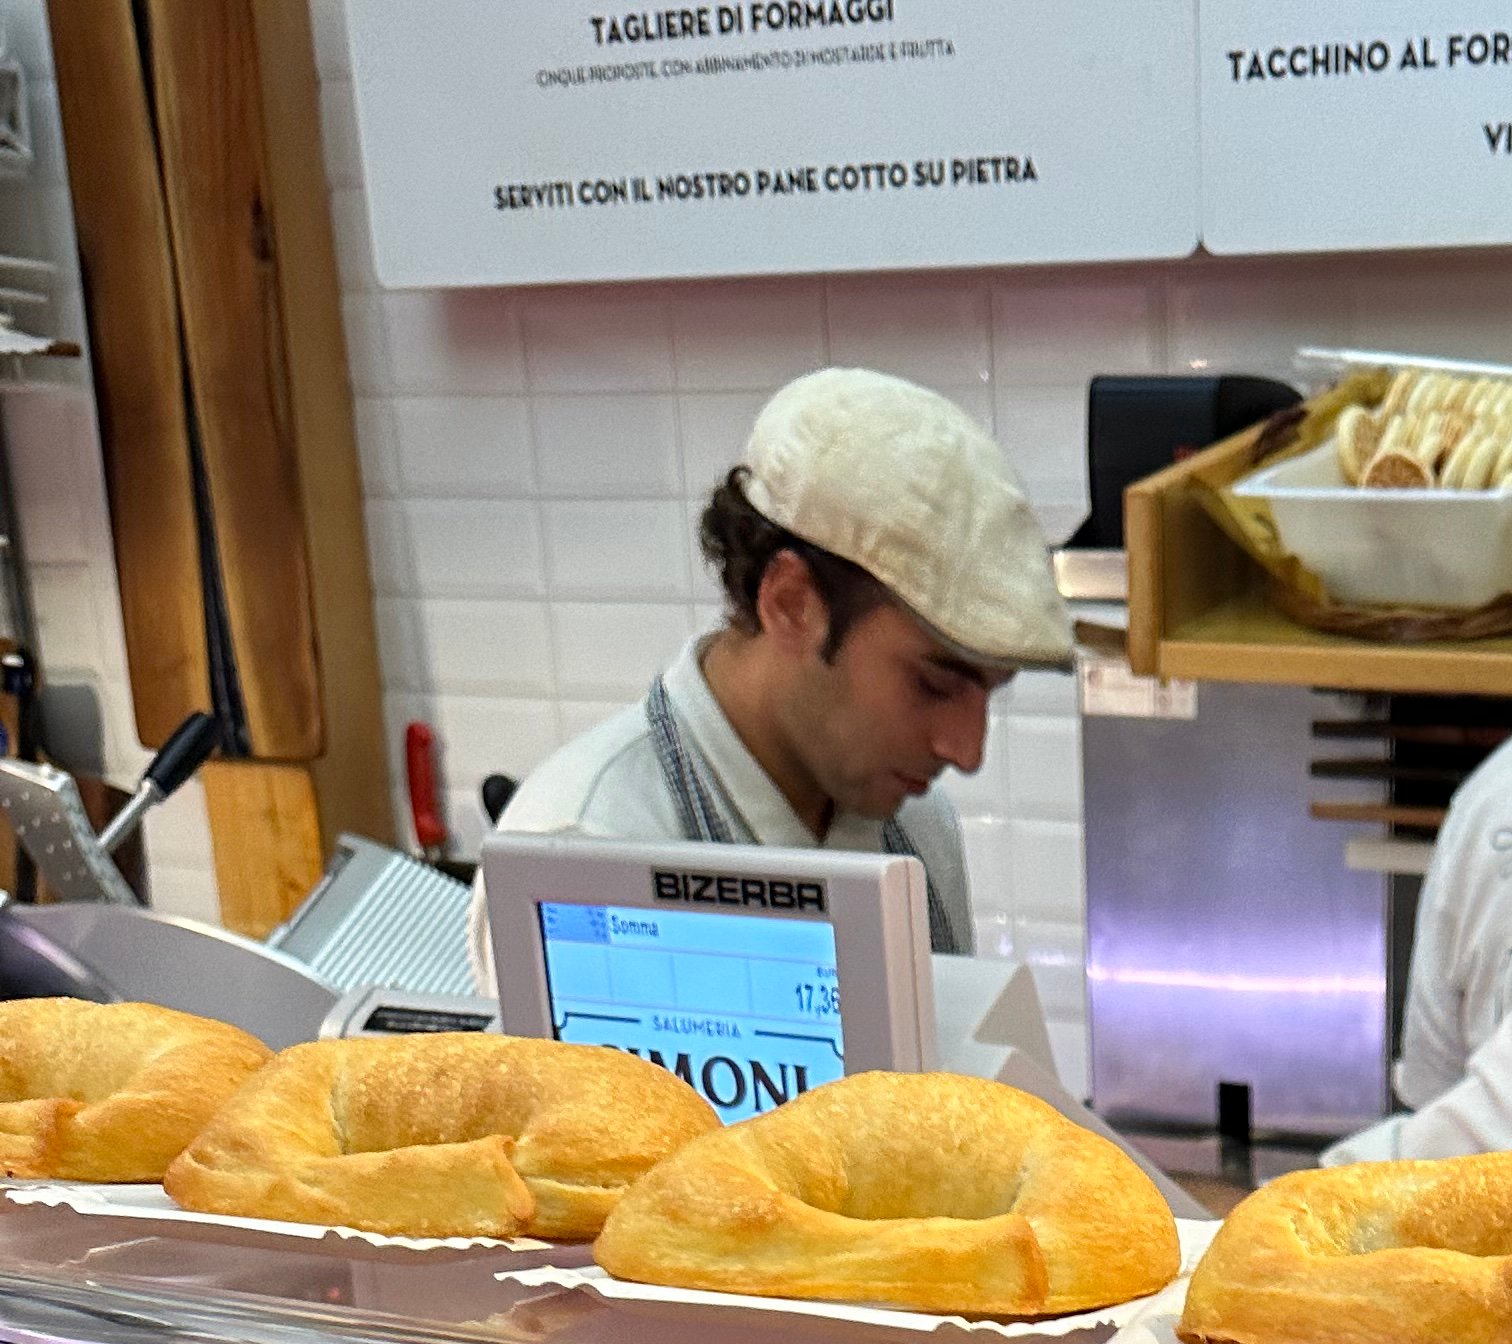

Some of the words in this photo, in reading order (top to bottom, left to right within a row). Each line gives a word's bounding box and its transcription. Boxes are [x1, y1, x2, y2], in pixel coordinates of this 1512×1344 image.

[590, 7, 713, 46] TAGLIERE
[718, 3, 744, 37] DI
[751, 0, 895, 32] FORMAGGI
[1226, 40, 1392, 82] TACCHINO
[1399, 35, 1438, 71] AL
[494, 181, 575, 210] SERVITI
[579, 176, 628, 205] CON
[631, 176, 654, 202] IL
[656, 171, 751, 201] NOSTRO
[756, 166, 820, 196] PANE
[823, 162, 909, 192] COTTO
[913, 158, 947, 187] SU
[952, 155, 1038, 186] PIETRA
[653, 872, 827, 911] BIZERBA
[652, 1015, 742, 1039] SALUMERIA
